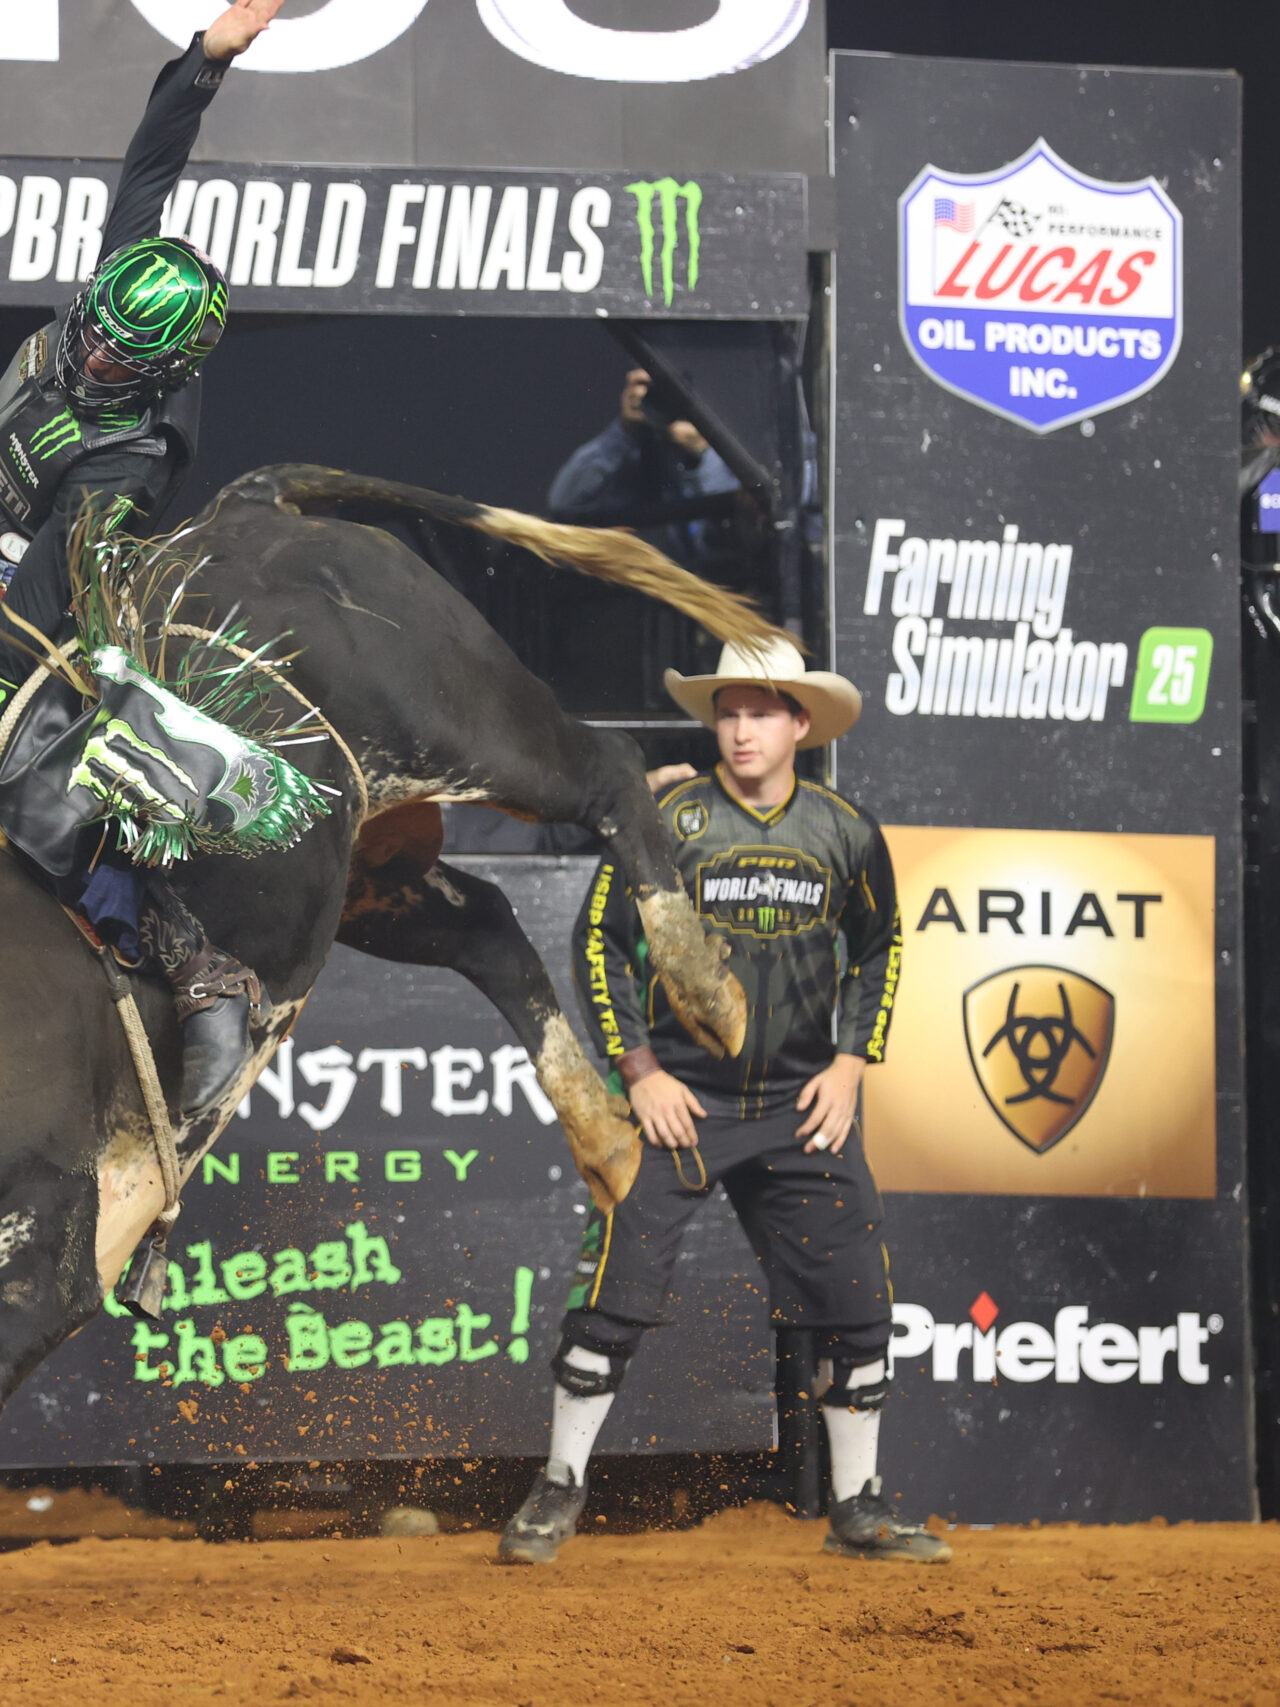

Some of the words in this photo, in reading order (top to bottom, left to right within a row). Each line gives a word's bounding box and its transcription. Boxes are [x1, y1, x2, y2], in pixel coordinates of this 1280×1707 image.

[160, 179, 367, 288] ORLD
[375, 184, 611, 293] FINALS
[933, 245, 1157, 306] LUCAS
[918, 318, 976, 352] OIL
[984, 322, 1162, 361] PRODUCTS
[1009, 366, 1078, 400] INC.
[9, 431, 40, 489] MONSTER
[863, 518, 1073, 639] Farming
[885, 615, 1128, 722] Simulator
[1147, 644, 1198, 706] 25
[703, 876, 761, 902] WORLD
[773, 877, 825, 906] FINALS
[916, 887, 1162, 939] ARIAT
[203, 1149, 479, 1185] NERGY
[131, 1318, 268, 1388] the
